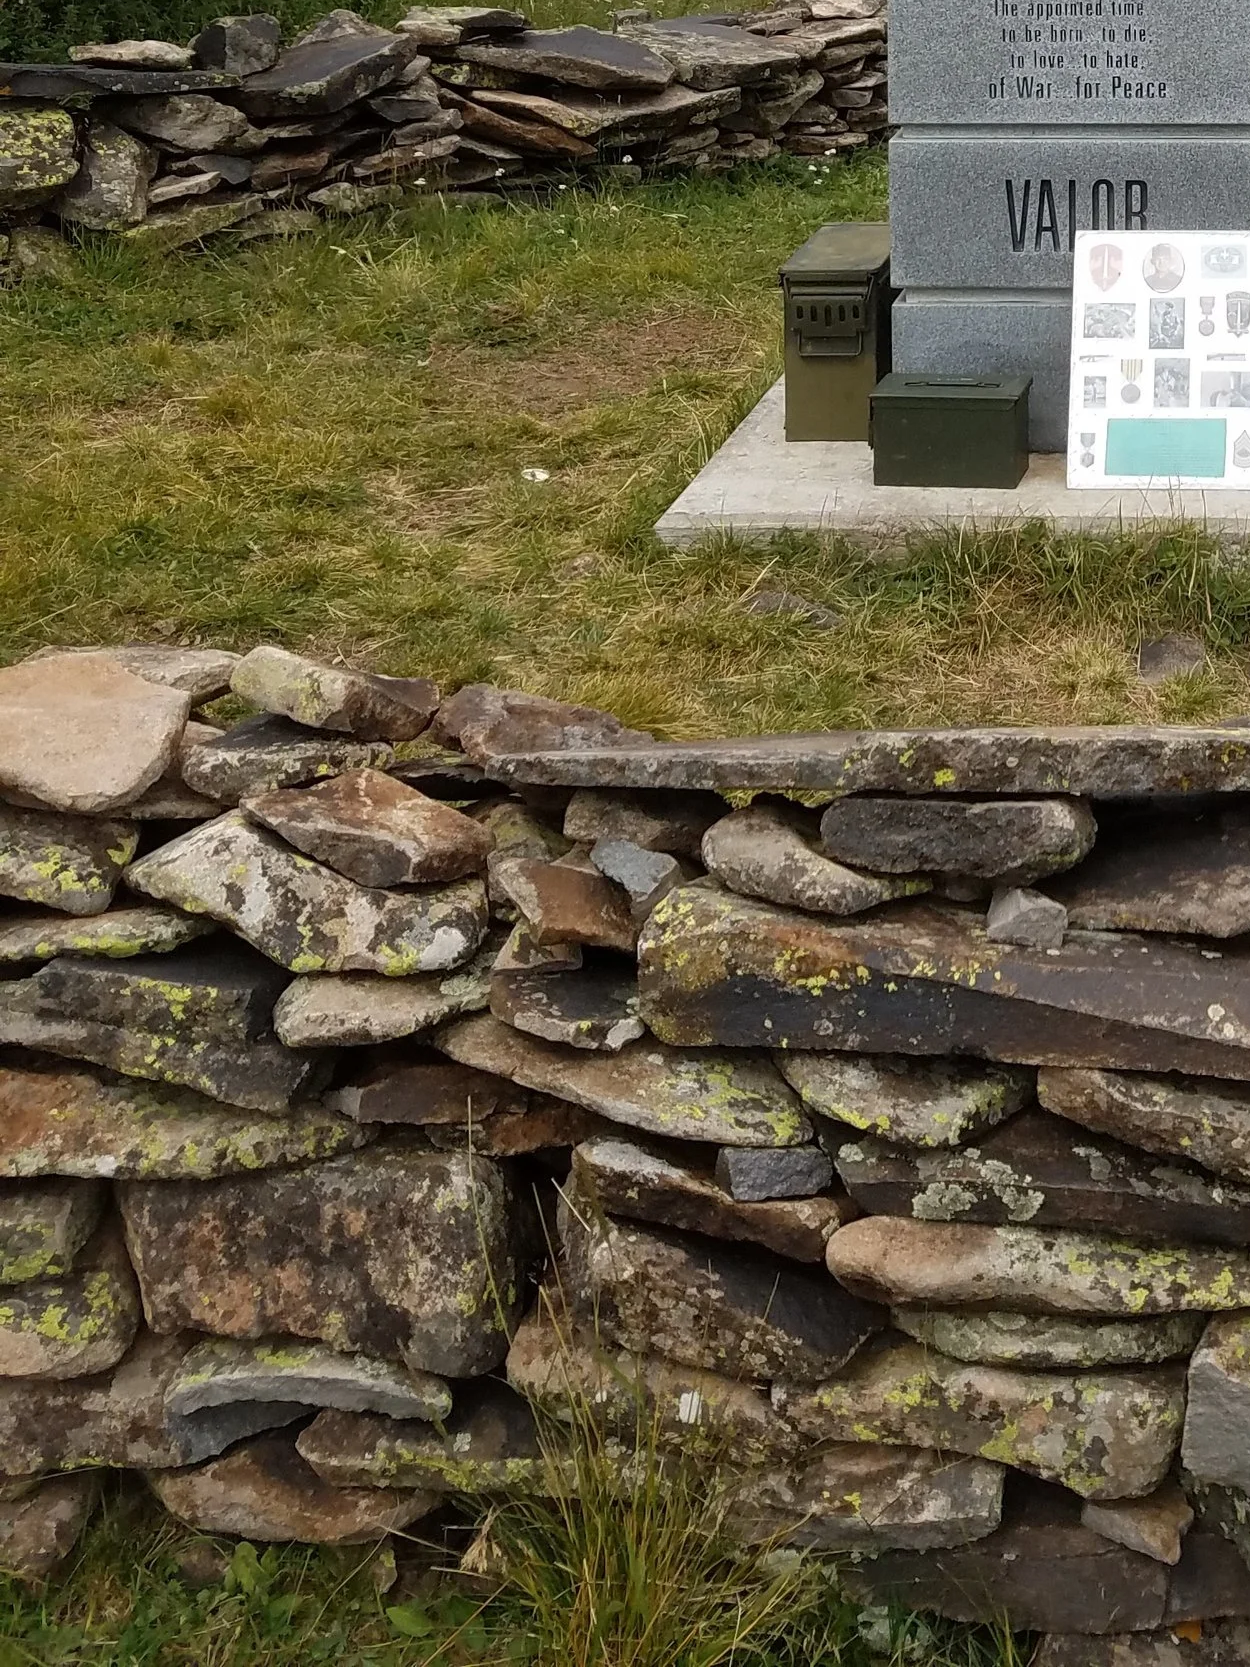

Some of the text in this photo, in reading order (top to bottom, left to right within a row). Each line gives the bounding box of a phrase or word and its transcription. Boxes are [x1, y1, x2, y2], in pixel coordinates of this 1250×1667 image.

[1002, 28, 1016, 43] to
[1025, 24, 1041, 43] be
[1102, 27, 1115, 43] to
[1011, 54, 1025, 69] to
[989, 76, 1005, 99] of
